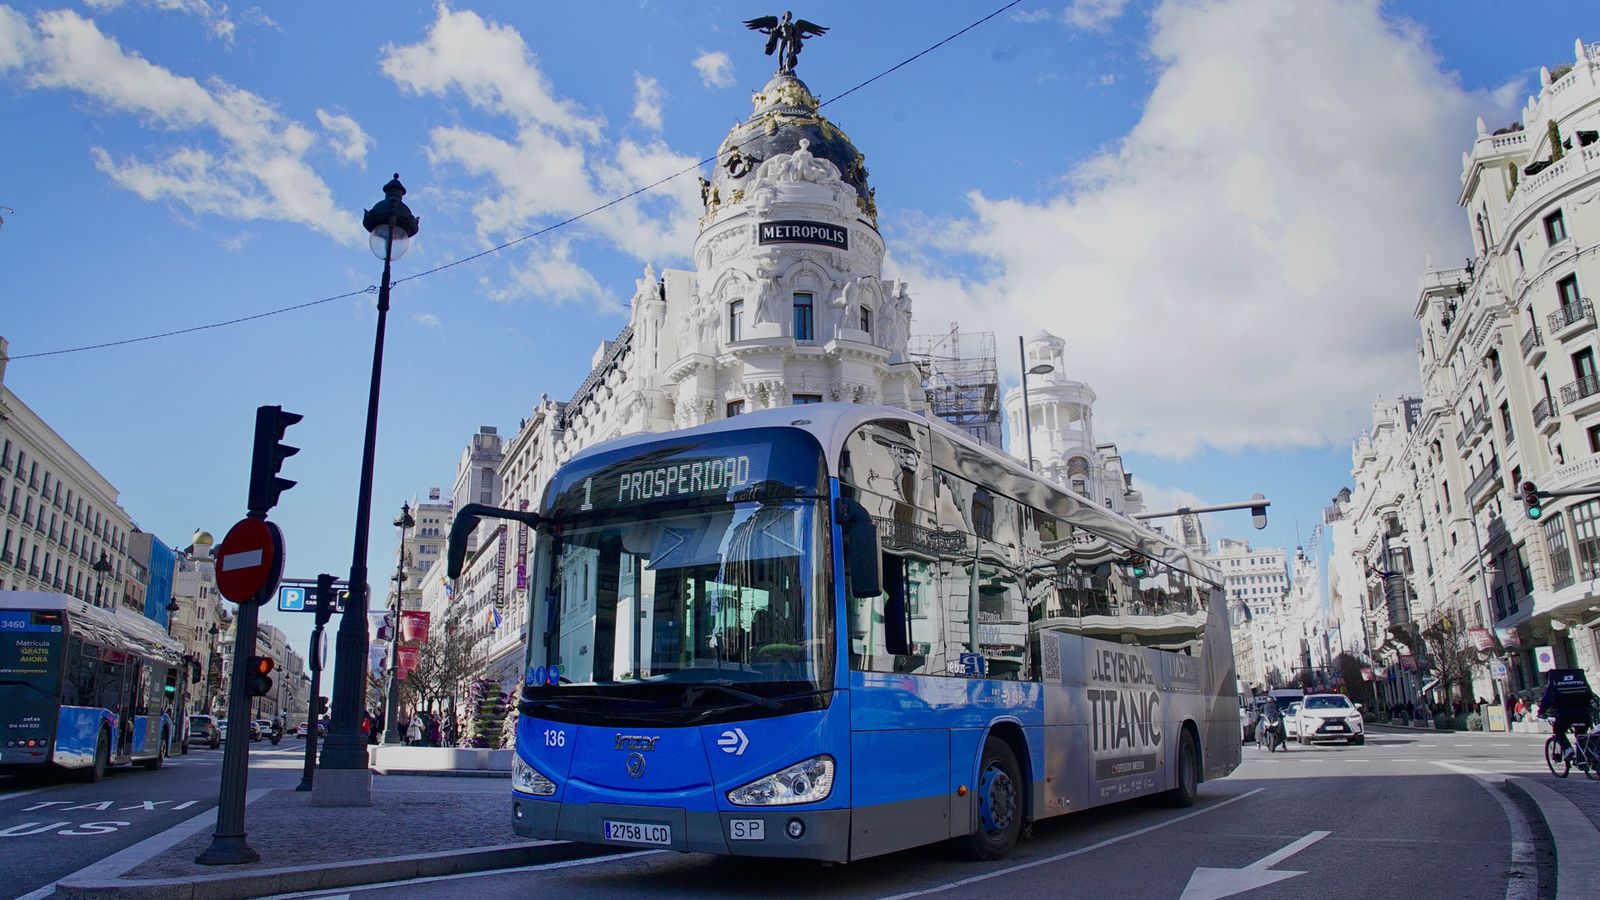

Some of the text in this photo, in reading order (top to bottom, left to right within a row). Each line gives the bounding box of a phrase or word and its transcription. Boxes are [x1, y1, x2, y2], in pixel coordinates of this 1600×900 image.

[763, 225, 844, 243] METROPOLIS
[580, 455, 750, 511] 1 PROSPERIDAD
[286, 590, 300, 607] P
[1, 620, 25, 629] 3460
[1096, 648, 1148, 685] LEYENDA
[1087, 689, 1161, 752] TITANIC
[544, 729, 565, 747] 136
[21, 801, 199, 811] TAXI
[612, 824, 668, 842] 2758 LCD
